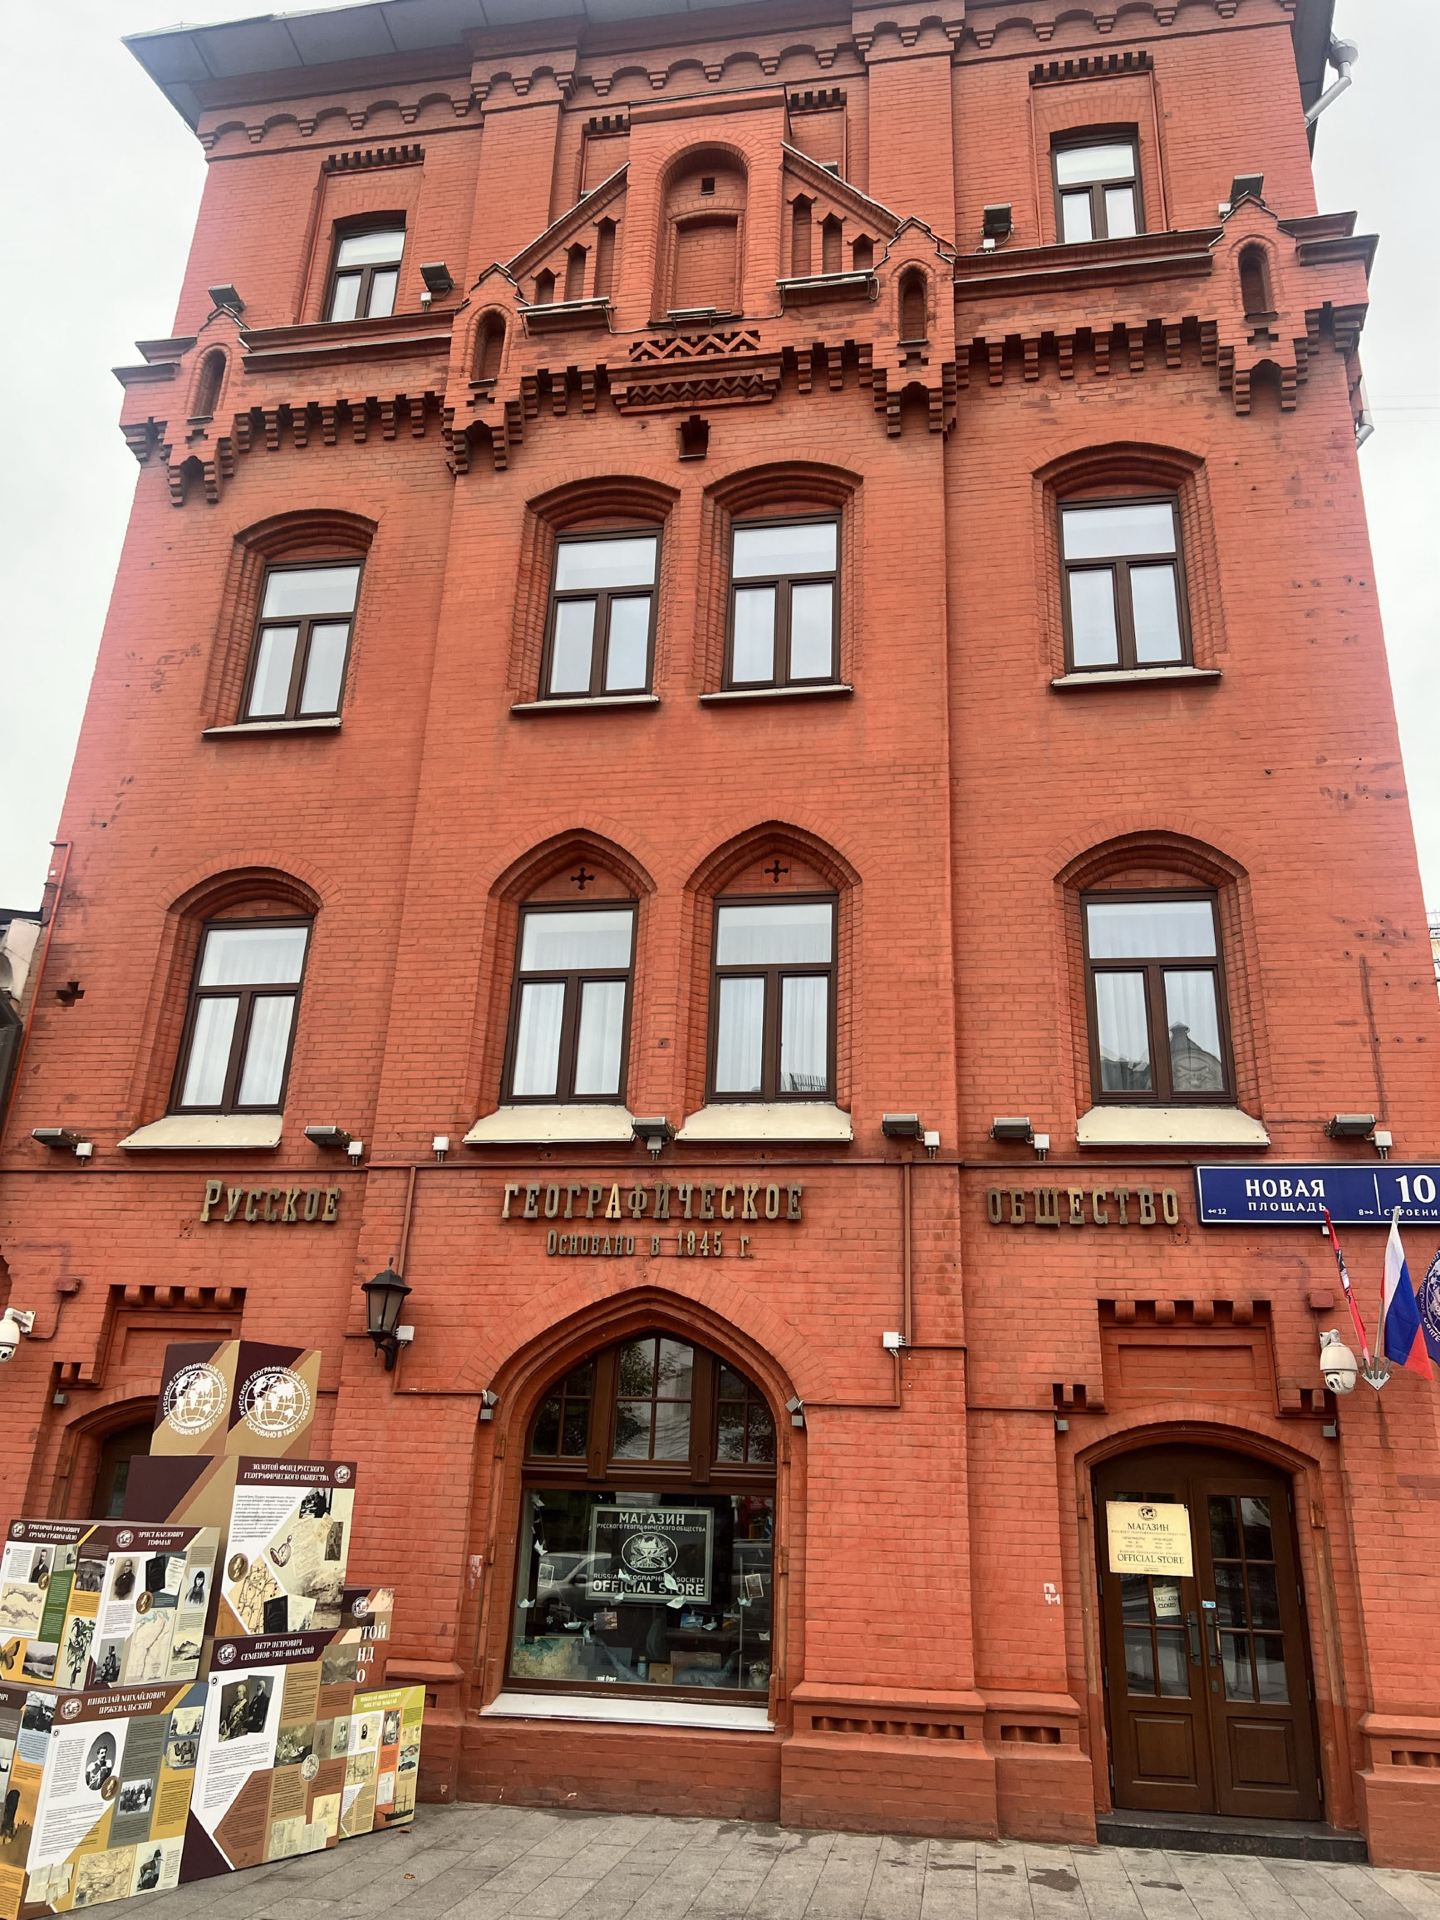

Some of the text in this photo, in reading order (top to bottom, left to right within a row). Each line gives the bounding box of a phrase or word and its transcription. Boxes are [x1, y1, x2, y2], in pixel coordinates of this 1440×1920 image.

[1245, 1179, 1326, 1198] НОВАЯ
[1395, 1174, 1436, 1204] 10
[502, 1183, 802, 1219] ГЕОГРАФИЧЕСКОЕ
[987, 1187, 1179, 1228] ОБЩЕСТВО
[1248, 1202, 1326, 1213] ПЛОЩАДЬ
[677, 1231, 723, 1257] 1845
[239, 1365, 311, 1421] РУССКОЕ ГЕОГРАФИЧЕСКОЕ ОБЩЕСТВО
[619, 1513, 685, 1526] МАГАЗИН
[1128, 1523, 1169, 1531] МАГАЗИН
[1117, 1554, 1184, 1564] OFFICIAL STORE
[593, 1580, 655, 1594] OFFICIAL
